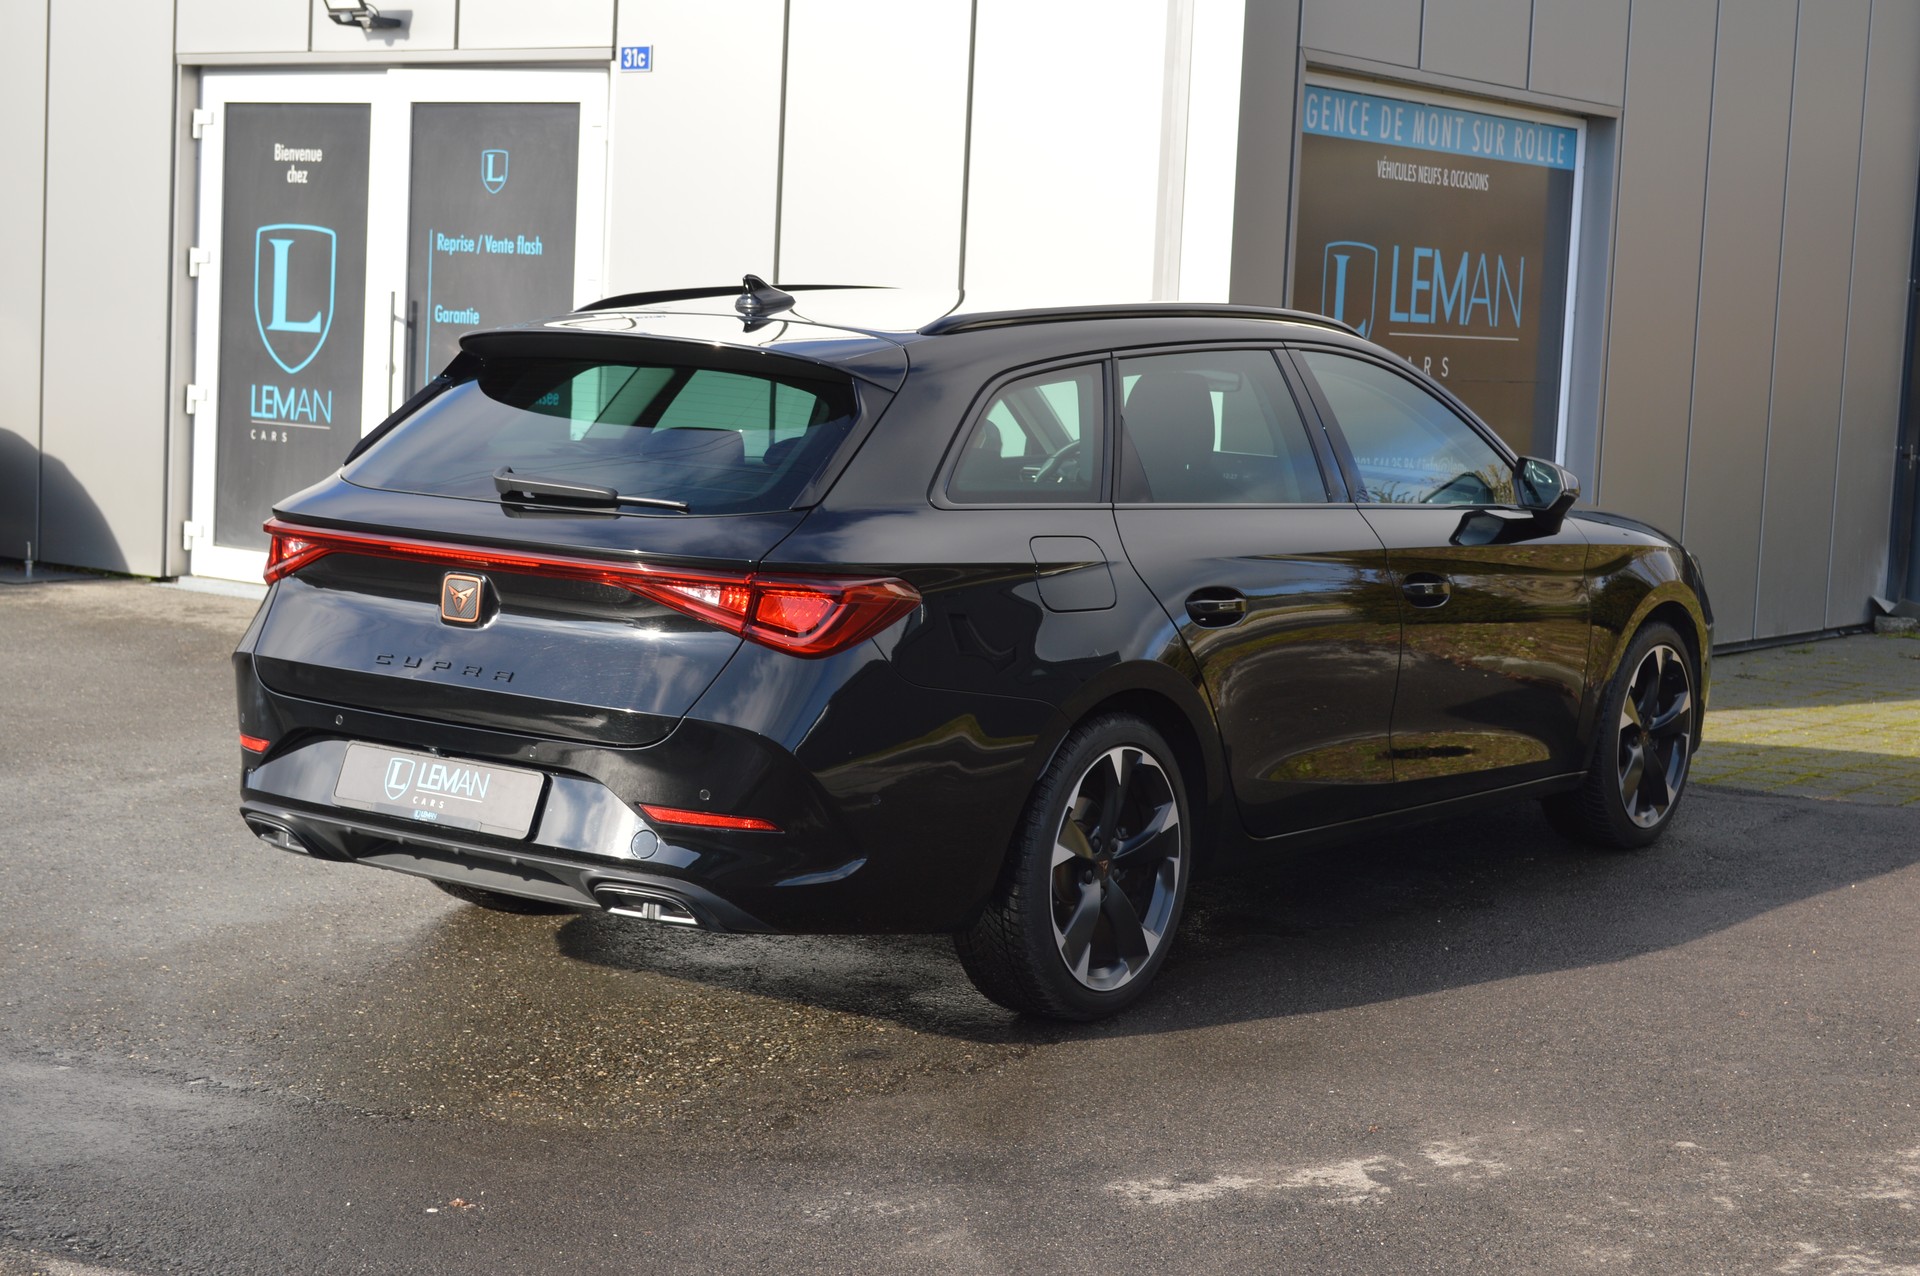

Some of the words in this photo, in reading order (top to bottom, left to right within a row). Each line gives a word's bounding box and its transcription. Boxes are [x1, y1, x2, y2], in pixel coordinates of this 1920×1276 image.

[624, 48, 646, 68] 31c
[1306, 94, 1369, 137] GENCE
[1380, 104, 1403, 141] DE
[1413, 110, 1464, 149] MONT
[1472, 119, 1505, 156] SUR
[1514, 127, 1565, 165] ROLLE
[274, 143, 323, 162] Bienvenue
[287, 165, 308, 184] chez
[486, 153, 504, 182] L
[1377, 155, 1417, 182] VÉHICULES
[1418, 166, 1442, 186] NEUFS
[1442, 169, 1449, 187] &
[1450, 170, 1489, 192] OCCASIONS
[437, 233, 474, 256] Reprise
[476, 234, 483, 255] /
[485, 234, 514, 254] Vente
[516, 235, 543, 255] flash
[266, 238, 322, 333] L
[1389, 245, 1525, 329] LEMAN
[434, 304, 480, 325] Garantie
[251, 384, 332, 423] LEMAN
[250, 429, 288, 443] CARS
[388, 761, 406, 790] L
[417, 762, 491, 799] LEMAN
[412, 796, 445, 809] CARS
